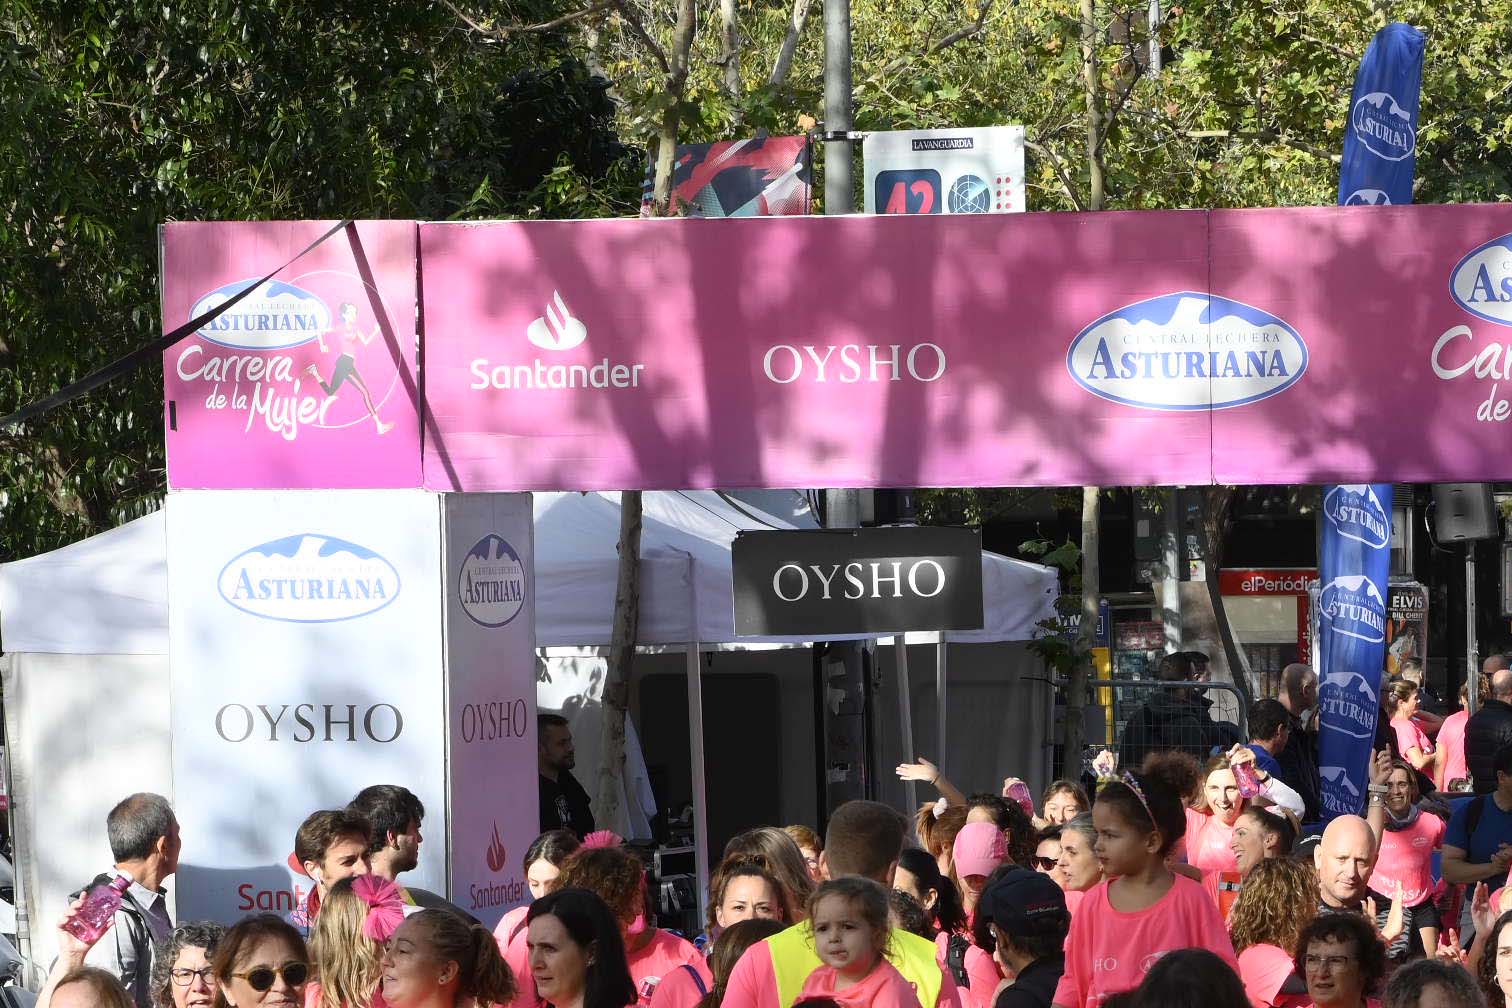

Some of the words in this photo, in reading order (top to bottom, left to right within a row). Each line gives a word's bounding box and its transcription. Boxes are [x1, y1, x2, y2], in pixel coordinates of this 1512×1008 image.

[200, 305, 318, 331] ASTURIANA
[1123, 334, 1198, 345] CENTRAL
[1206, 332, 1280, 343] LECHERA
[177, 345, 293, 382] Carrera
[471, 358, 644, 390] Santander
[763, 343, 946, 384] OYSHO
[1087, 336, 1289, 379] ASTURIANA
[206, 384, 227, 410] de
[232, 384, 248, 410] la
[245, 379, 338, 441] Mujer
[1477, 383, 1511, 422] de
[233, 567, 386, 600] ASTURIANA
[464, 575, 522, 604] ASTURIANA
[773, 559, 946, 601] OYSHO
[1242, 575, 1318, 593] elPeriódi
[1392, 595, 1424, 609] ELVIS
[216, 703, 403, 743] OYSHO
[462, 699, 528, 743] OYSHO
[470, 880, 524, 910] Santander
